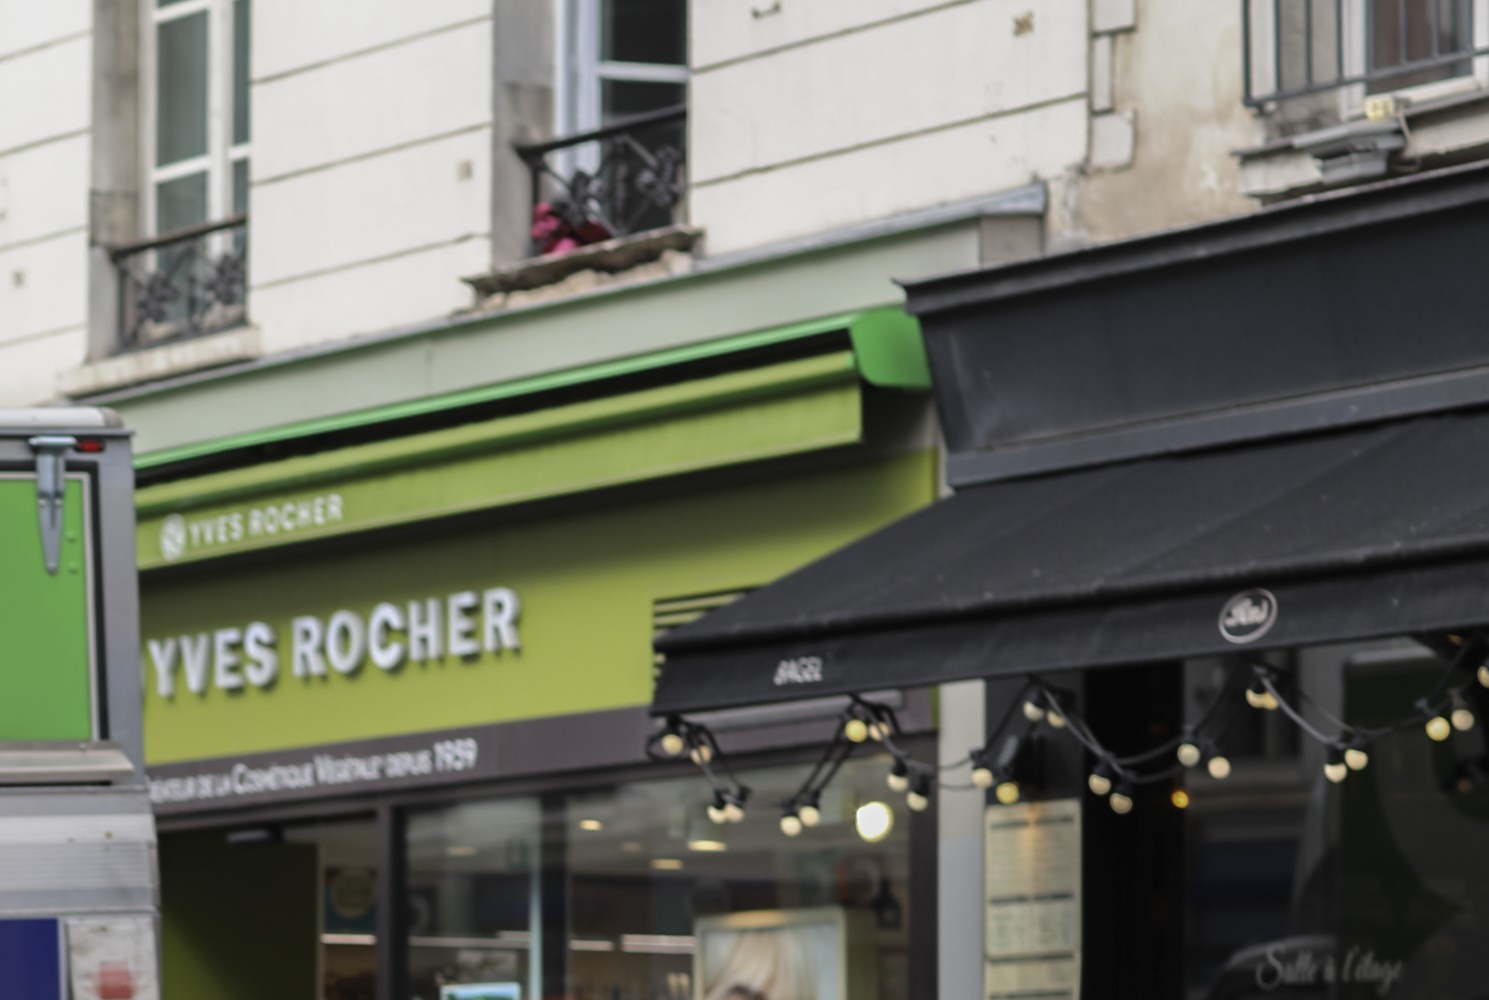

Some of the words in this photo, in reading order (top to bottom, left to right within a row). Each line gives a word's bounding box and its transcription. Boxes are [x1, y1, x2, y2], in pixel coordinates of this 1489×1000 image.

[189, 513, 243, 547] YVES
[249, 494, 343, 537] ROCHER
[147, 621, 277, 698] YVES
[291, 586, 521, 677] ROCHER
[433, 737, 478, 773] 1959
